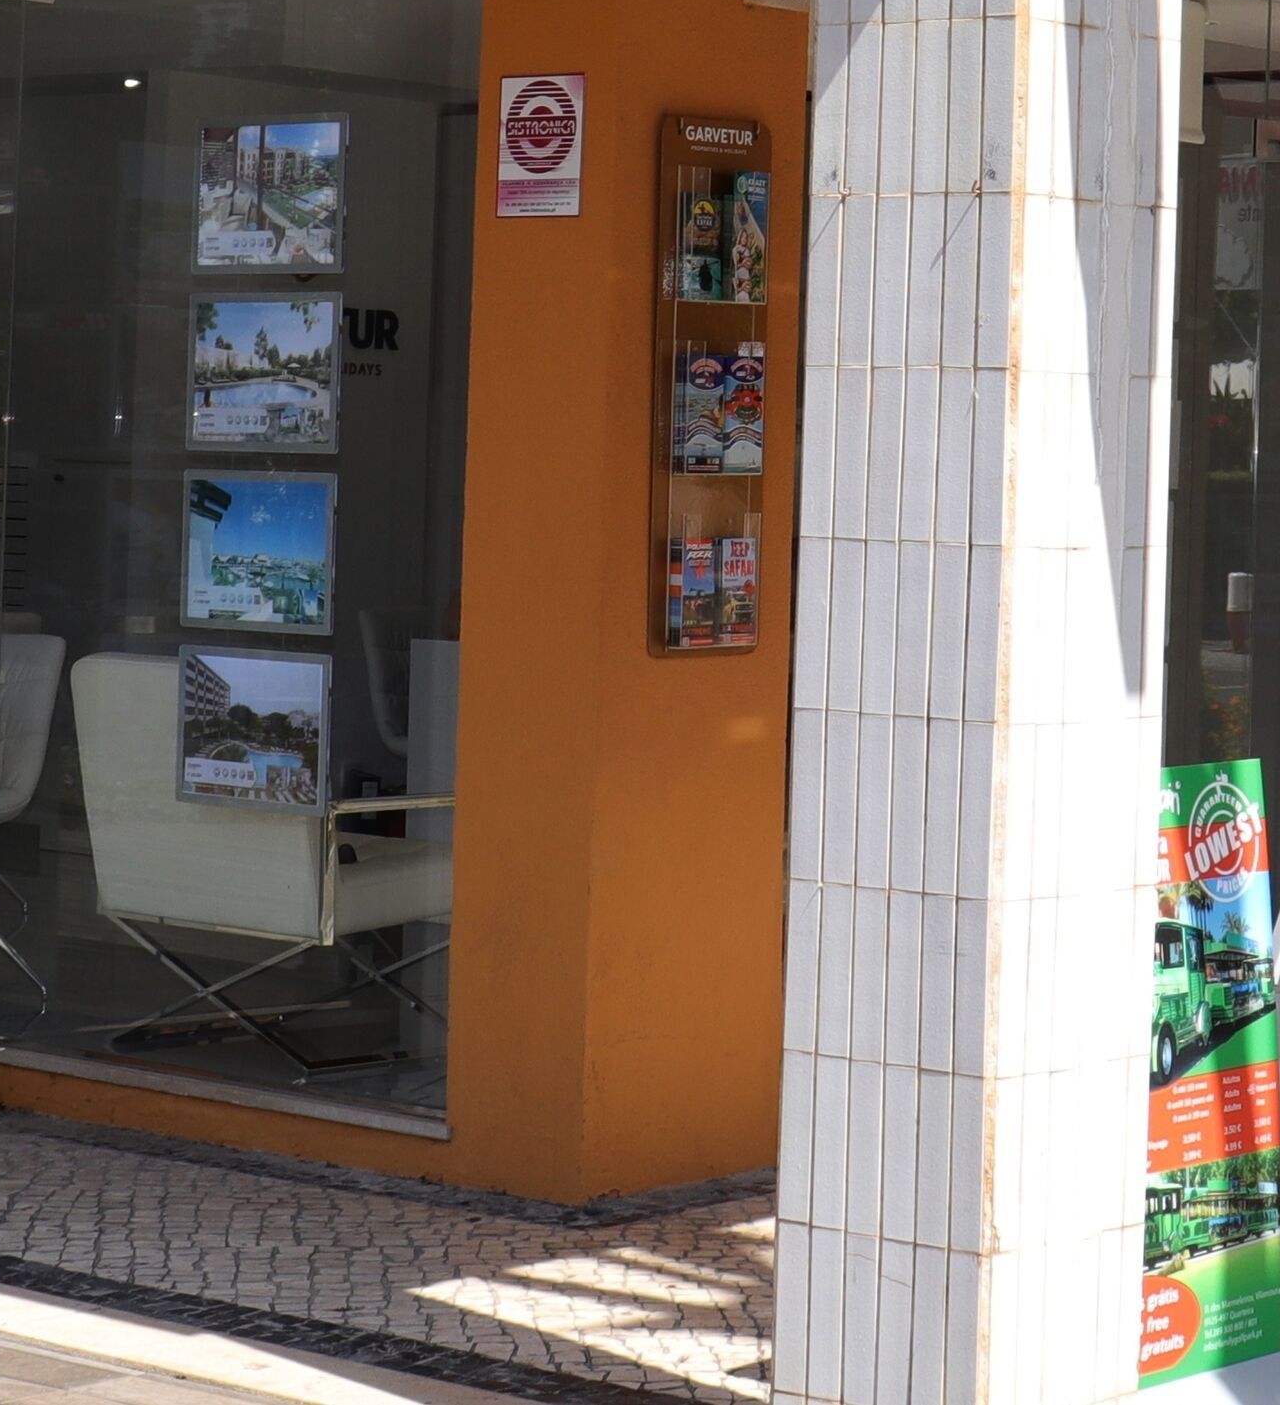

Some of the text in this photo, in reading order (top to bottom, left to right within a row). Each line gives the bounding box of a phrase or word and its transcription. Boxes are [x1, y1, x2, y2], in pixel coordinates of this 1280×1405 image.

[507, 120, 575, 136] SISTRONICA
[685, 125, 753, 146] GARVETUR
[730, 540, 750, 557] JEEP
[724, 560, 754, 576] SAFARI
[1195, 792, 1242, 838] GUARANTEED
[1184, 802, 1262, 881] LOWEST
[1147, 1287, 1179, 1313] grátis
[1147, 1316, 1169, 1334] free
[1140, 1334, 1184, 1362] gratuits
